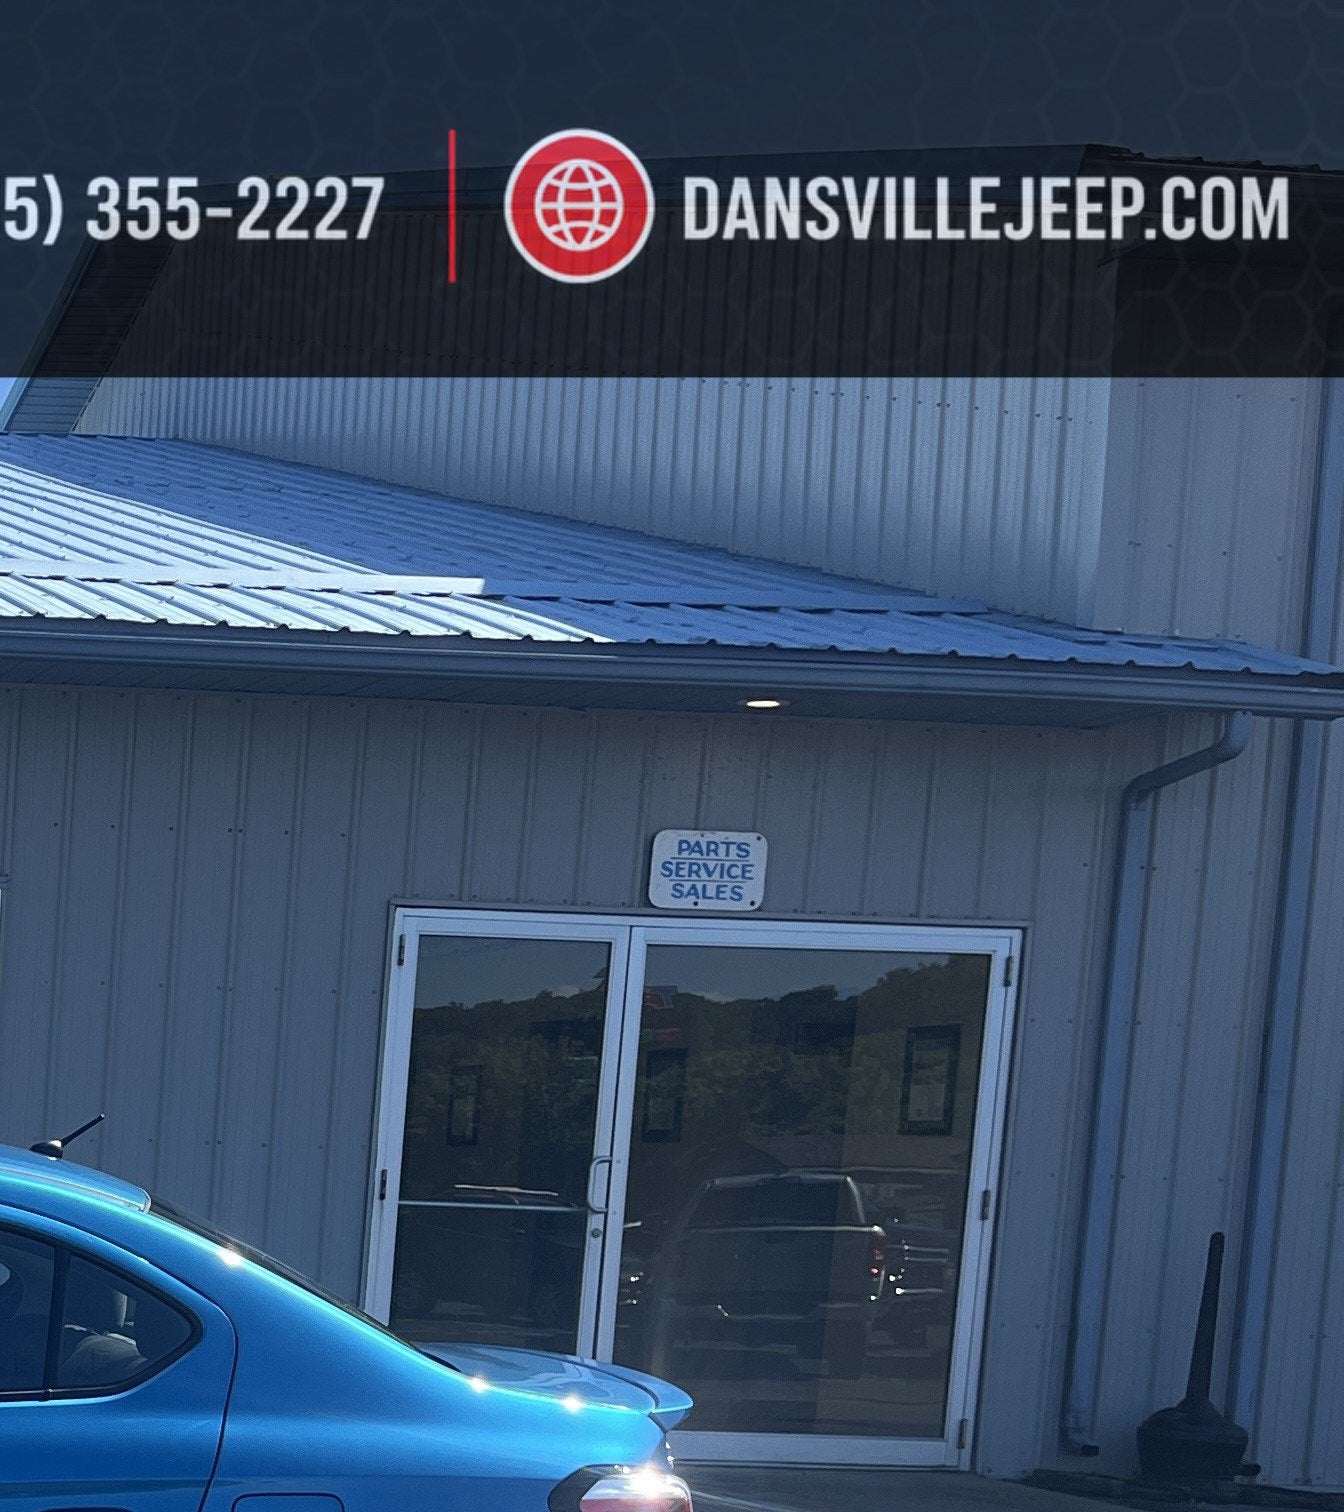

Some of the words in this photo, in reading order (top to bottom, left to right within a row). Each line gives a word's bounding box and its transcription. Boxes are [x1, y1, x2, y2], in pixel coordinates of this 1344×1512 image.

[677, 838, 752, 859] PARTS
[659, 860, 756, 881] SERVICE
[670, 882, 744, 902] SALES
